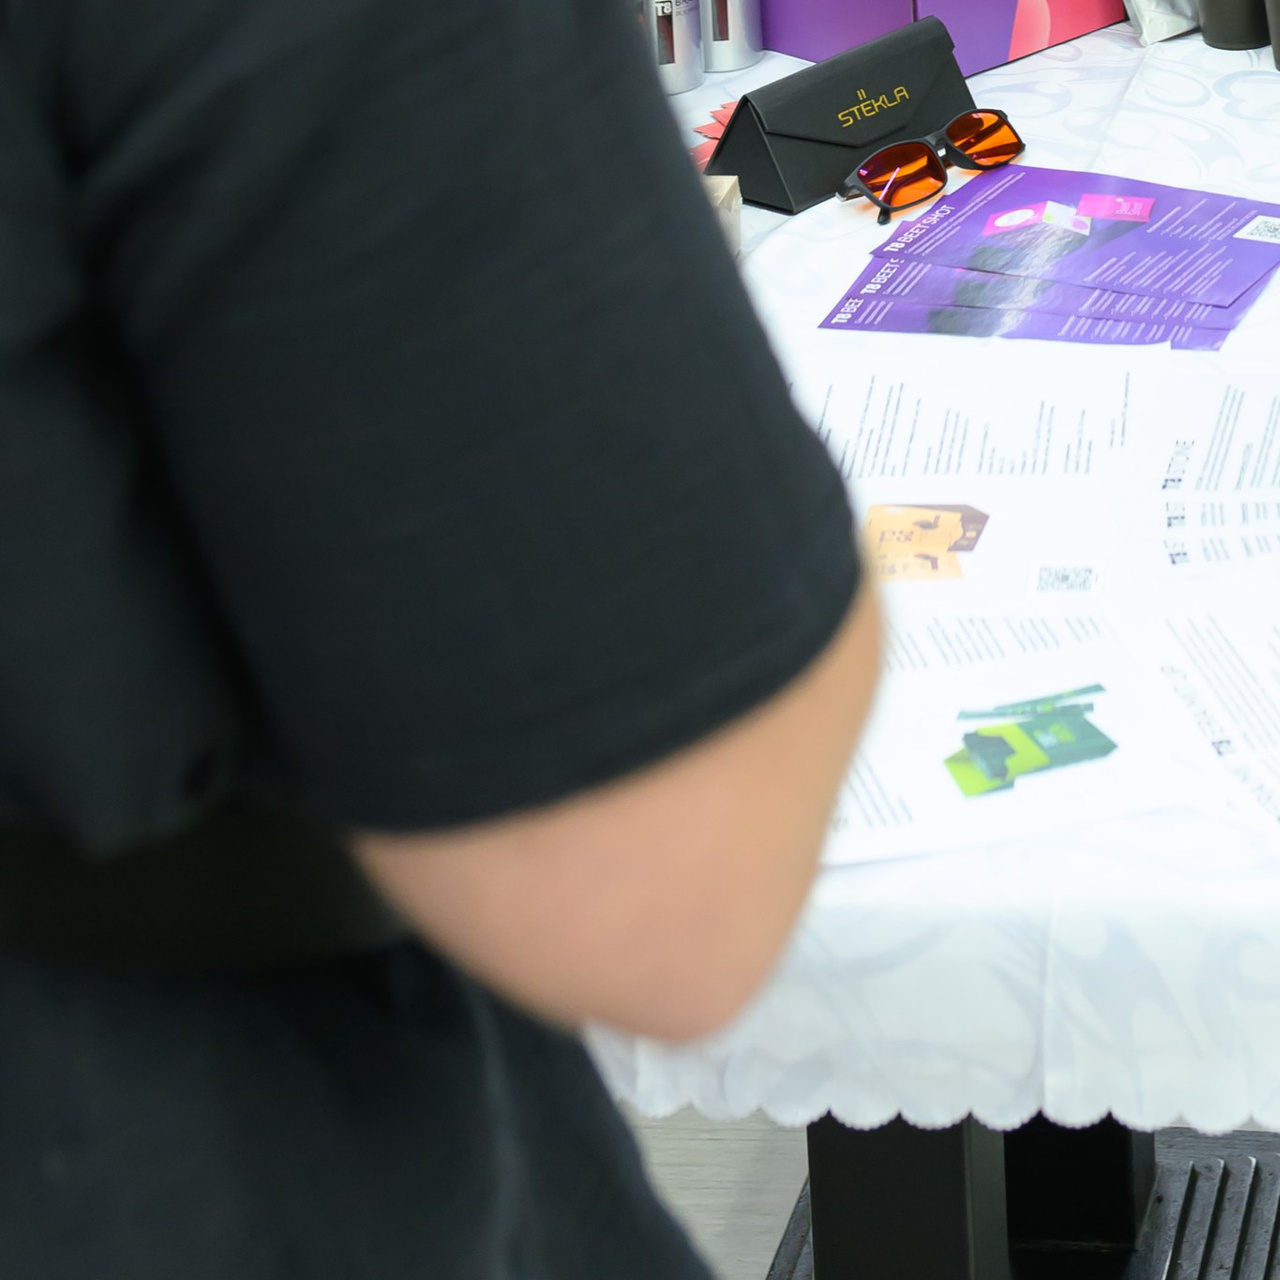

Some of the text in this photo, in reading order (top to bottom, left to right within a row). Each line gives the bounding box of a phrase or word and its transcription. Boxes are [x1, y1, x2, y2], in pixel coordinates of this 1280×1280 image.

[655, 2, 672, 16] T8
[883, 204, 956, 252] T8 BEET SHOT
[870, 262, 900, 284] BEET
[860, 283, 882, 294] T8
[831, 313, 852, 324] T8
